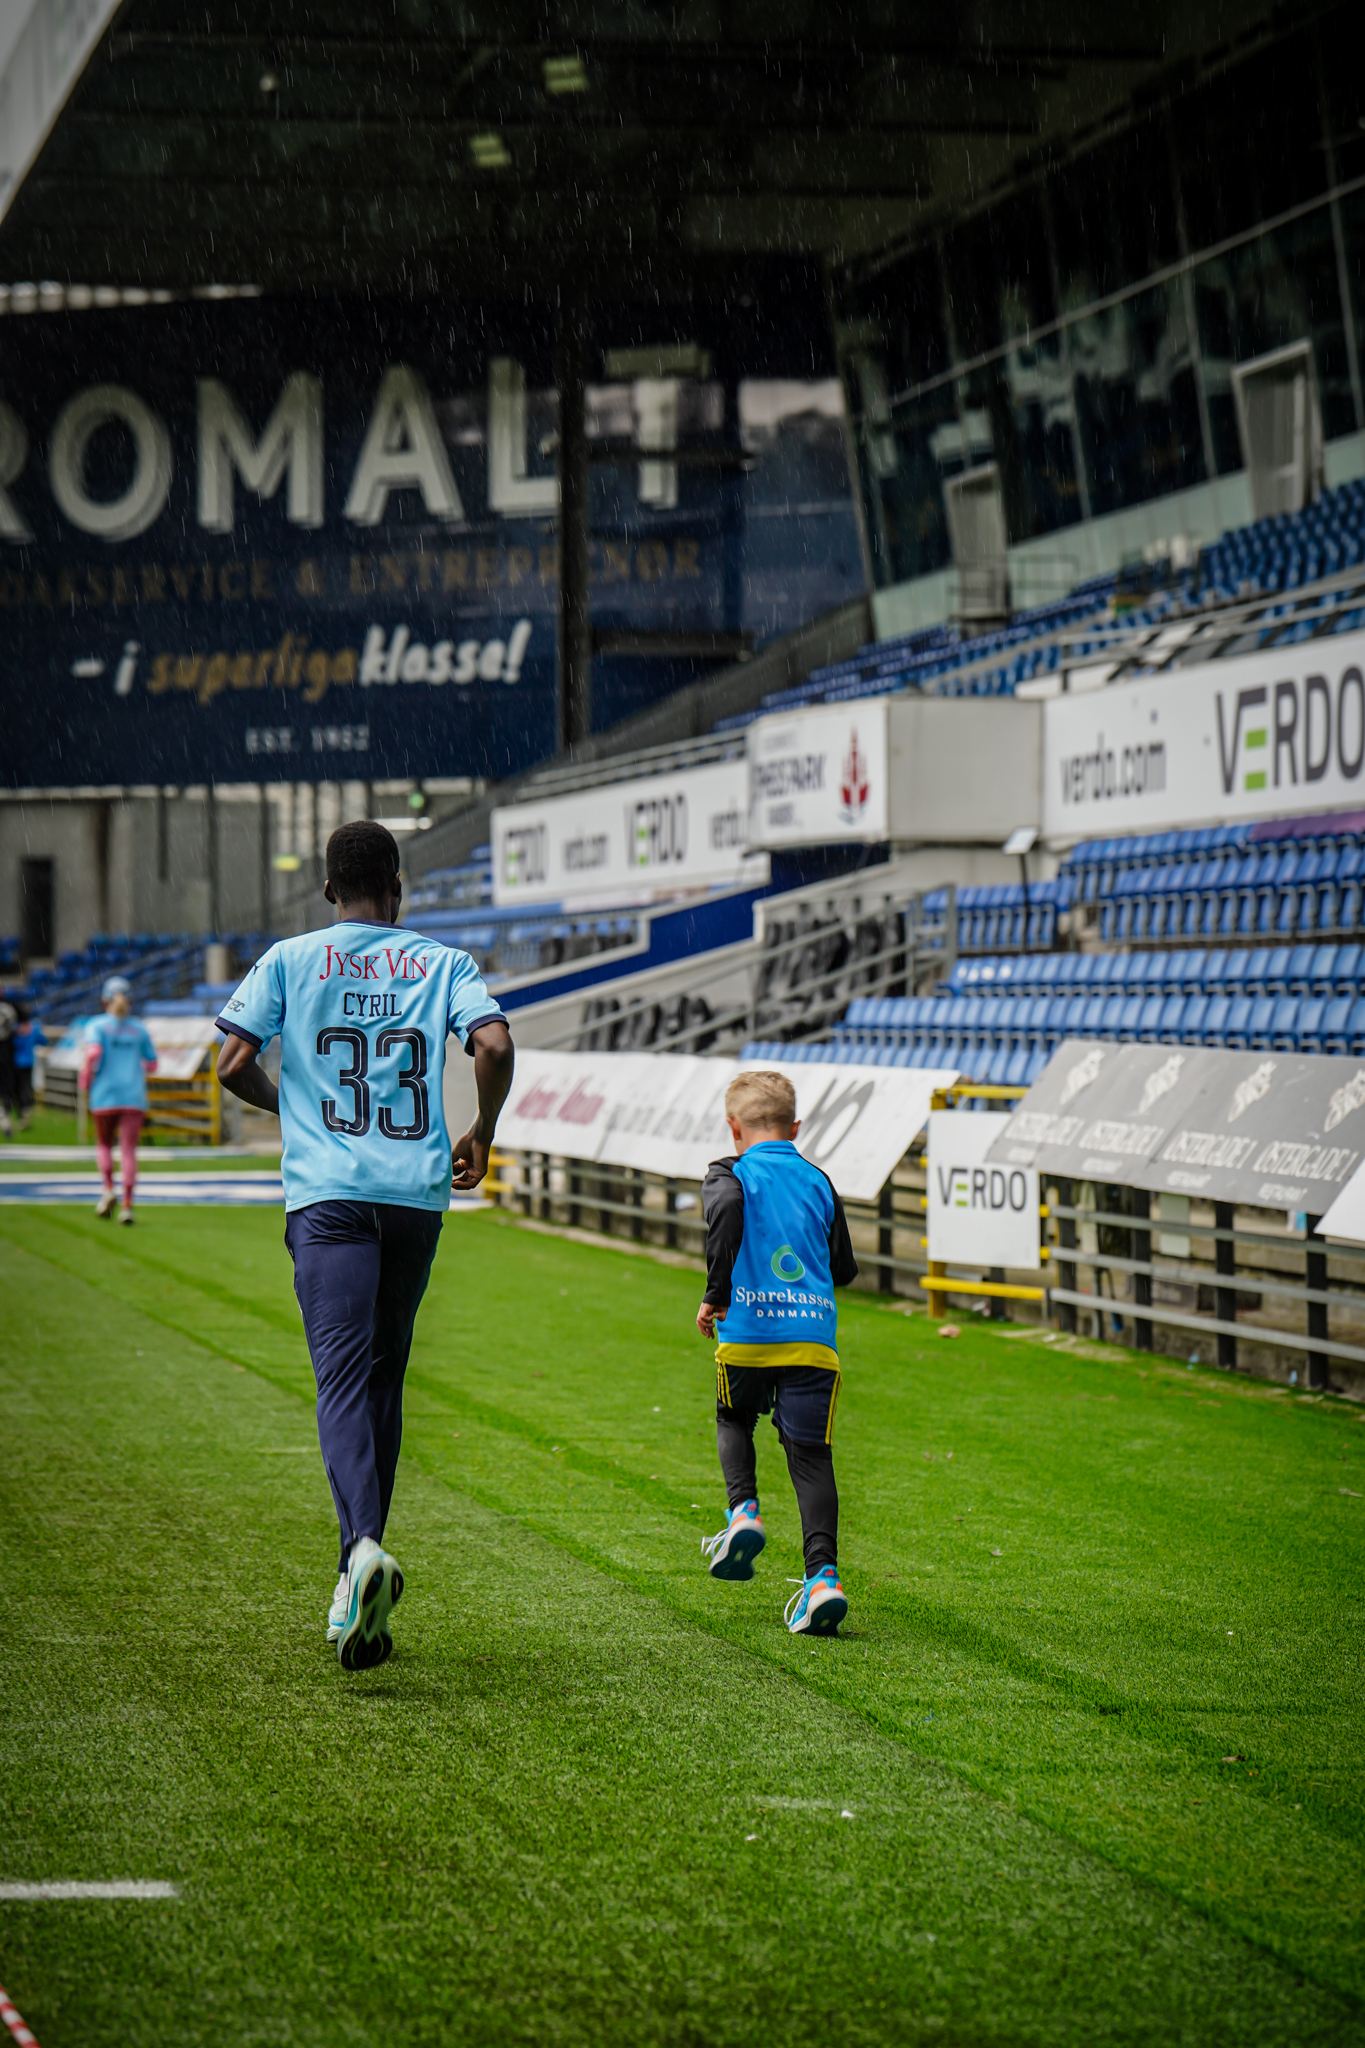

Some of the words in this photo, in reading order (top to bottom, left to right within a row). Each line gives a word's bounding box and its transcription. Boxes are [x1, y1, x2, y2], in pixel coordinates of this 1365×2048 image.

[1215, 662, 1365, 795] VERDO
[1060, 731, 1167, 805] verdo.com
[319, 944, 380, 981] JYSK
[382, 948, 428, 980] VIN
[343, 992, 402, 1018] CYRIL
[316, 1026, 430, 1141] 33
[937, 1164, 1027, 1213] VERDO
[735, 1286, 836, 1312] Sparekassen
[757, 1308, 825, 1322] DANMARK
